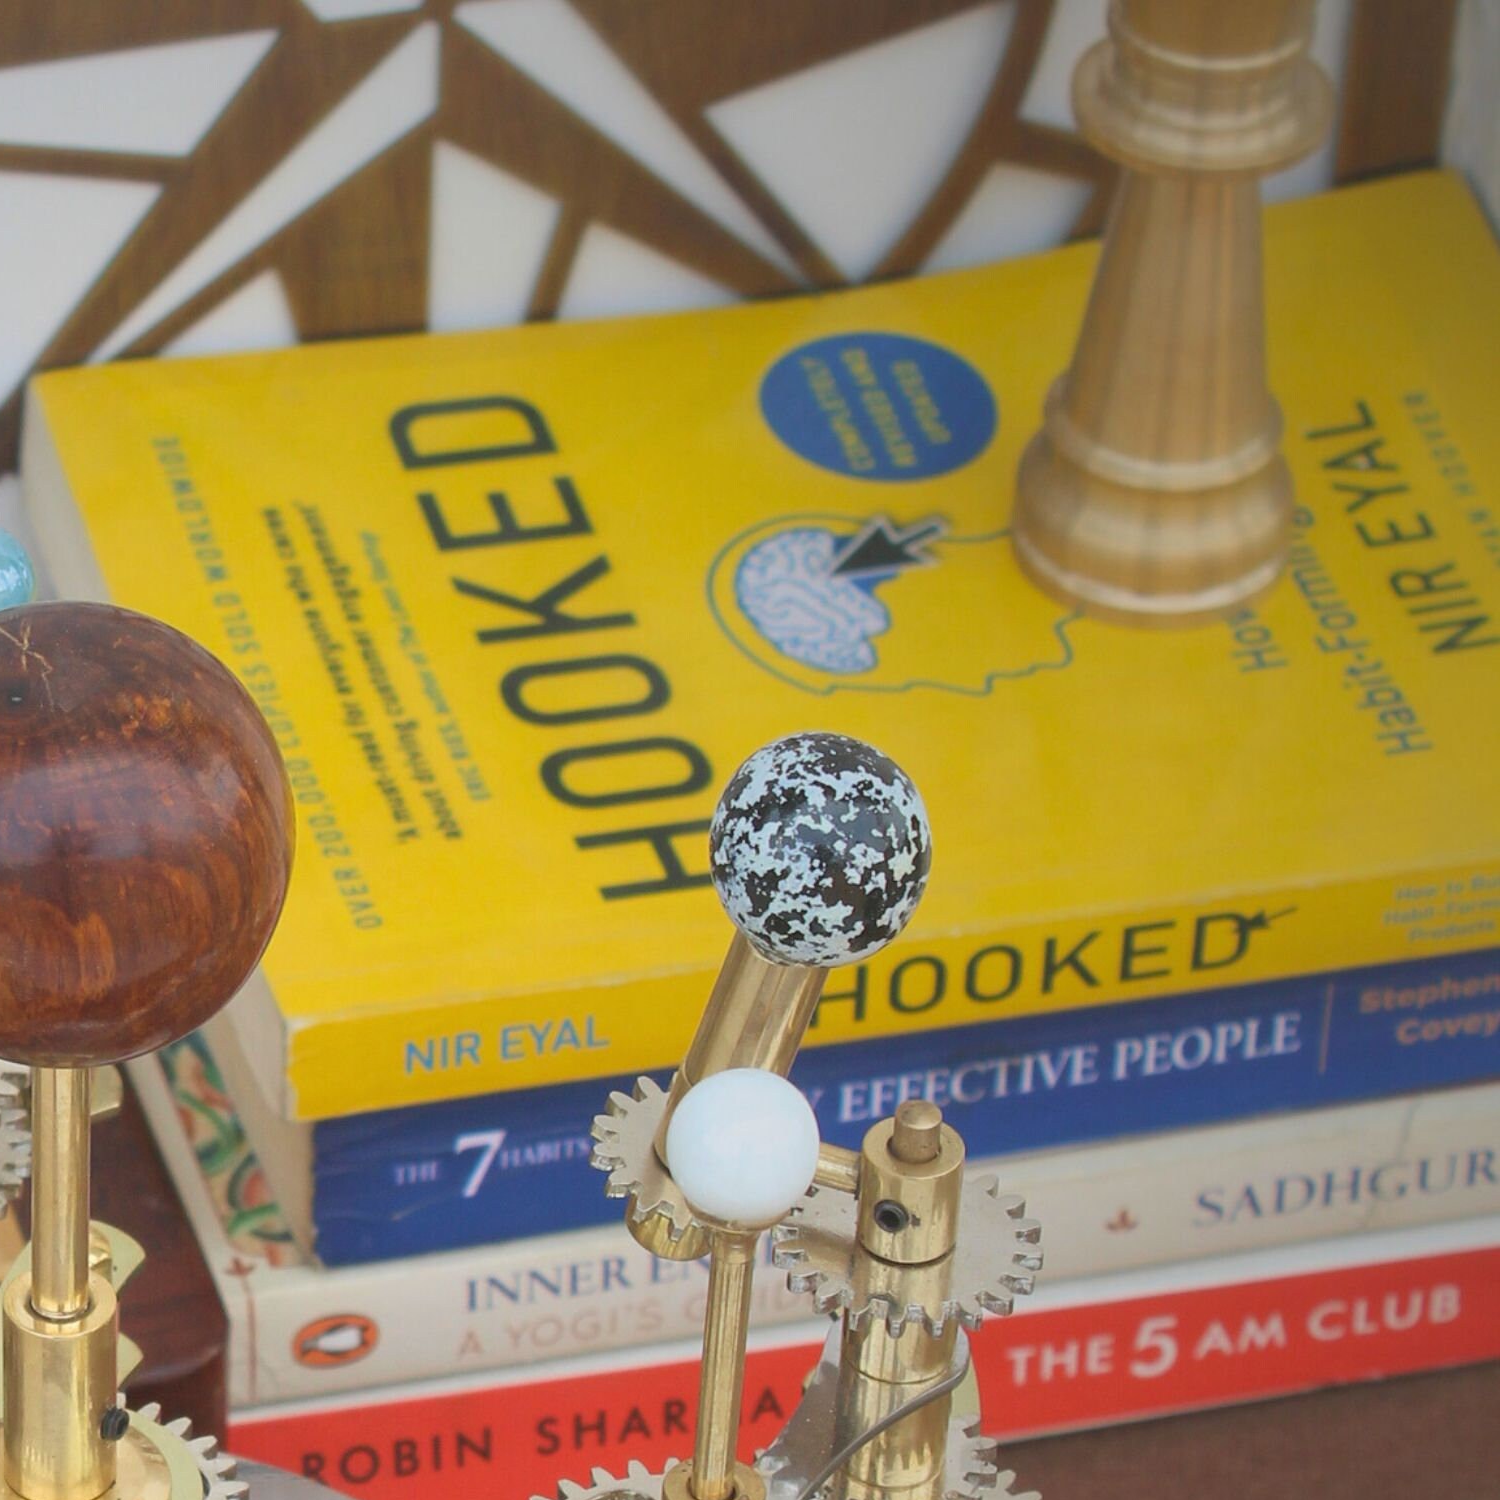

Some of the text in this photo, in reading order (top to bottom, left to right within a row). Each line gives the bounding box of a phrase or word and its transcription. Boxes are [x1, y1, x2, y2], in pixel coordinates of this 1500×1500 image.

[152, 436, 227, 582] WORLDWIDE
[1305, 399, 1500, 654] NIR EYAL
[213, 592, 262, 654] SOLD
[285, 565, 312, 603] who
[304, 609, 352, 694] everyone
[353, 629, 404, 716] customer
[389, 394, 714, 902] HOOKED
[242, 663, 301, 749] COPIES
[343, 702, 366, 727] for
[393, 720, 436, 785] driving
[422, 787, 463, 840] about
[334, 868, 383, 930] OVER
[808, 912, 1250, 1030] HOOKED
[404, 1015, 610, 1075] NIR EYAL
[393, 1159, 440, 1187] THE
[454, 1128, 508, 1198] 7
[499, 1137, 592, 1171] HABITS
[838, 1043, 1100, 1124] EFFECTIVE
[1110, 1012, 1303, 1083] PEOPLE
[1193, 1147, 1500, 1229] SADHGUR
[464, 1255, 631, 1314] INNER
[494, 1300, 666, 1357] YOGI'S
[1005, 1283, 1463, 1387] THE 5 AM CLUB
[299, 1388, 785, 1487] ROBIN SHARA
